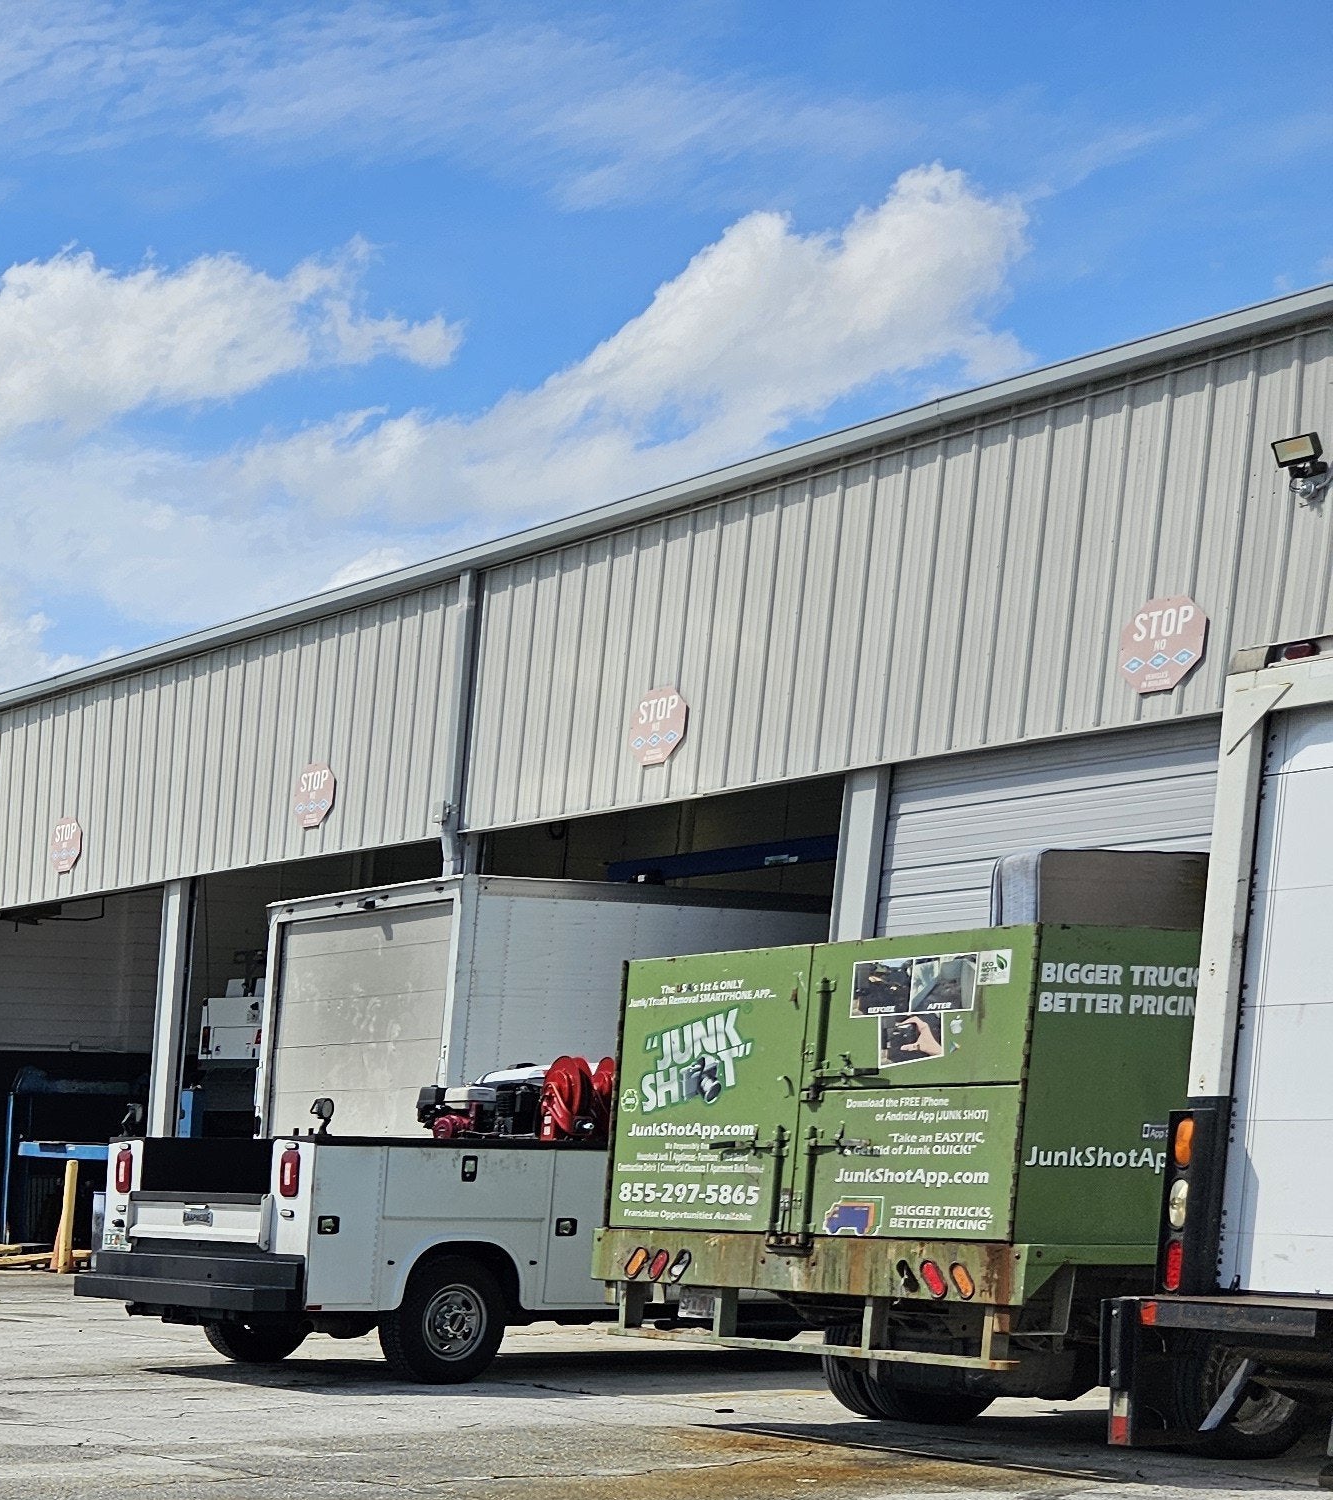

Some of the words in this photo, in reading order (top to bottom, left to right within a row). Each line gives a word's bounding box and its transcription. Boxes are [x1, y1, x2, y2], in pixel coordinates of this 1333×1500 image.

[1132, 605, 1194, 642] STOP
[1153, 638, 1167, 652] NO
[638, 694, 679, 724] STOP
[300, 769, 329, 793] STOP
[54, 822, 77, 843] STOP
[1040, 962, 1124, 985] BIGGER
[719, 978, 745, 990] ONLY
[926, 1001, 952, 1011] AFTER
[1038, 991, 1124, 1014] BETTER
[846, 1097, 884, 1109] Download
[885, 1097, 899, 1107] the
[899, 1097, 921, 1107] FREE
[920, 1096, 950, 1107] iPhone
[874, 1113, 884, 1121] or
[884, 1111, 917, 1122] Android
[917, 1111, 935, 1124] App
[627, 1122, 755, 1140] JunkShotApp.com
[918, 1135, 933, 1143] an
[934, 1132, 963, 1143] EASY
[964, 1132, 986, 1144] PIC,
[890, 1144, 904, 1155] of
[903, 1144, 931, 1155] Junk
[834, 1168, 990, 1188] JunkShotApp.com
[618, 1182, 760, 1205] 855-297-5865
[623, 1208, 659, 1218] Franchise
[659, 1209, 713, 1221] Opportunities
[713, 1211, 753, 1221] Available
[943, 1205, 994, 1219] TRUCKS,
[889, 1218, 934, 1229] BETTER
